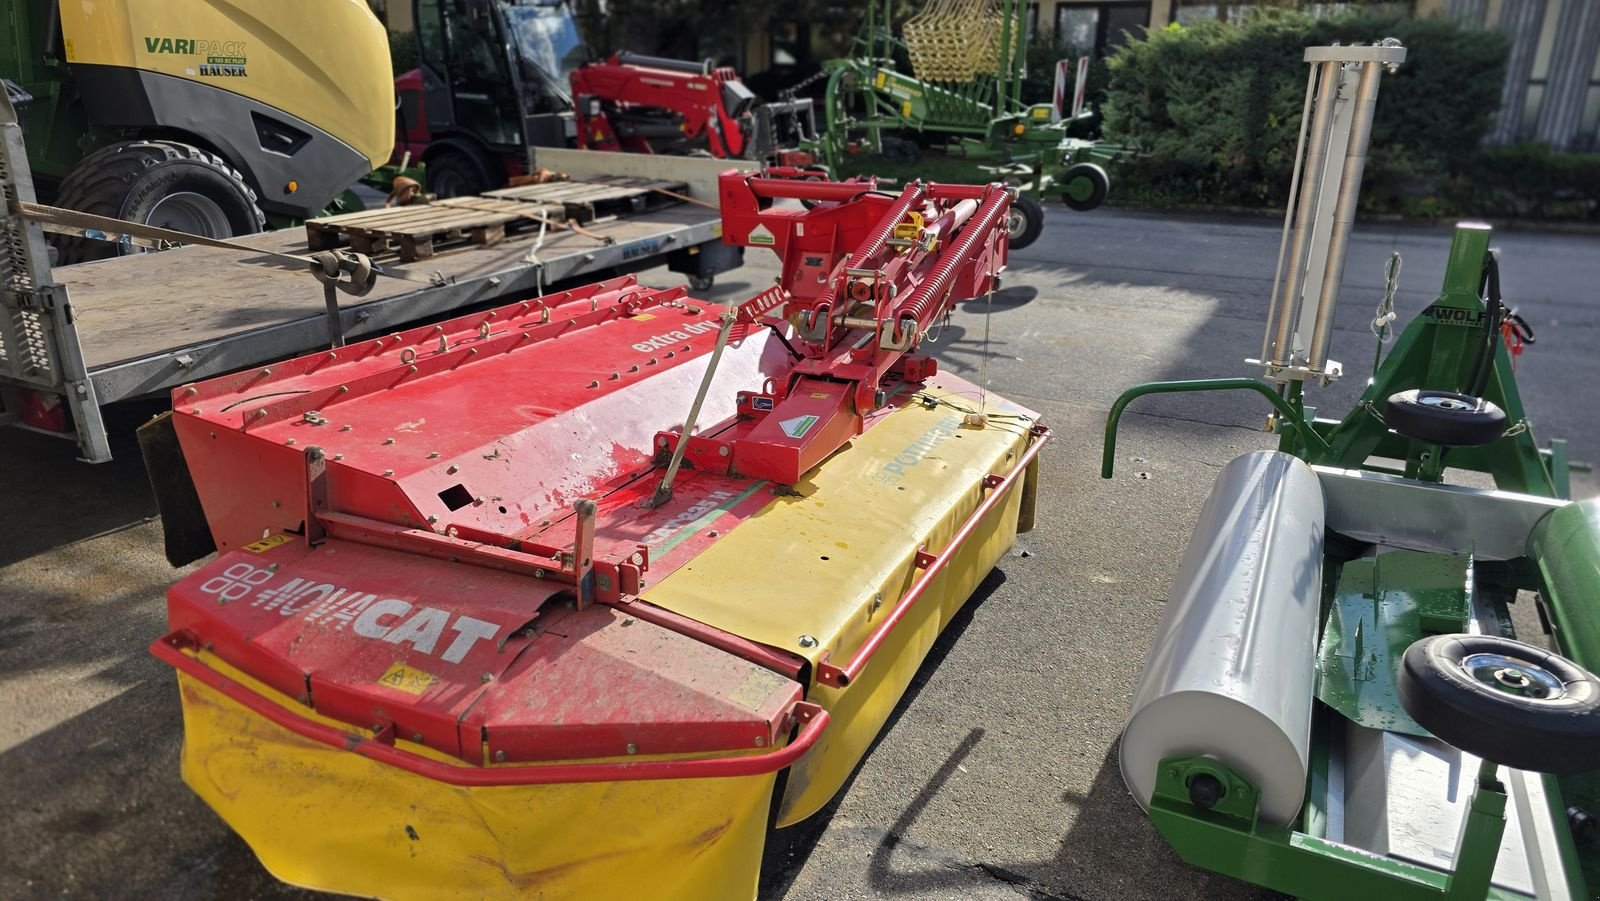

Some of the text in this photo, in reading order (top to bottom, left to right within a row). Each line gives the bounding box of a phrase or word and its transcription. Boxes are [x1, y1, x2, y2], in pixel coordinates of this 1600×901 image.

[144, 36, 247, 57] VARIPACK
[1435, 308, 1487, 322] WOLF
[631, 330, 692, 353] extra
